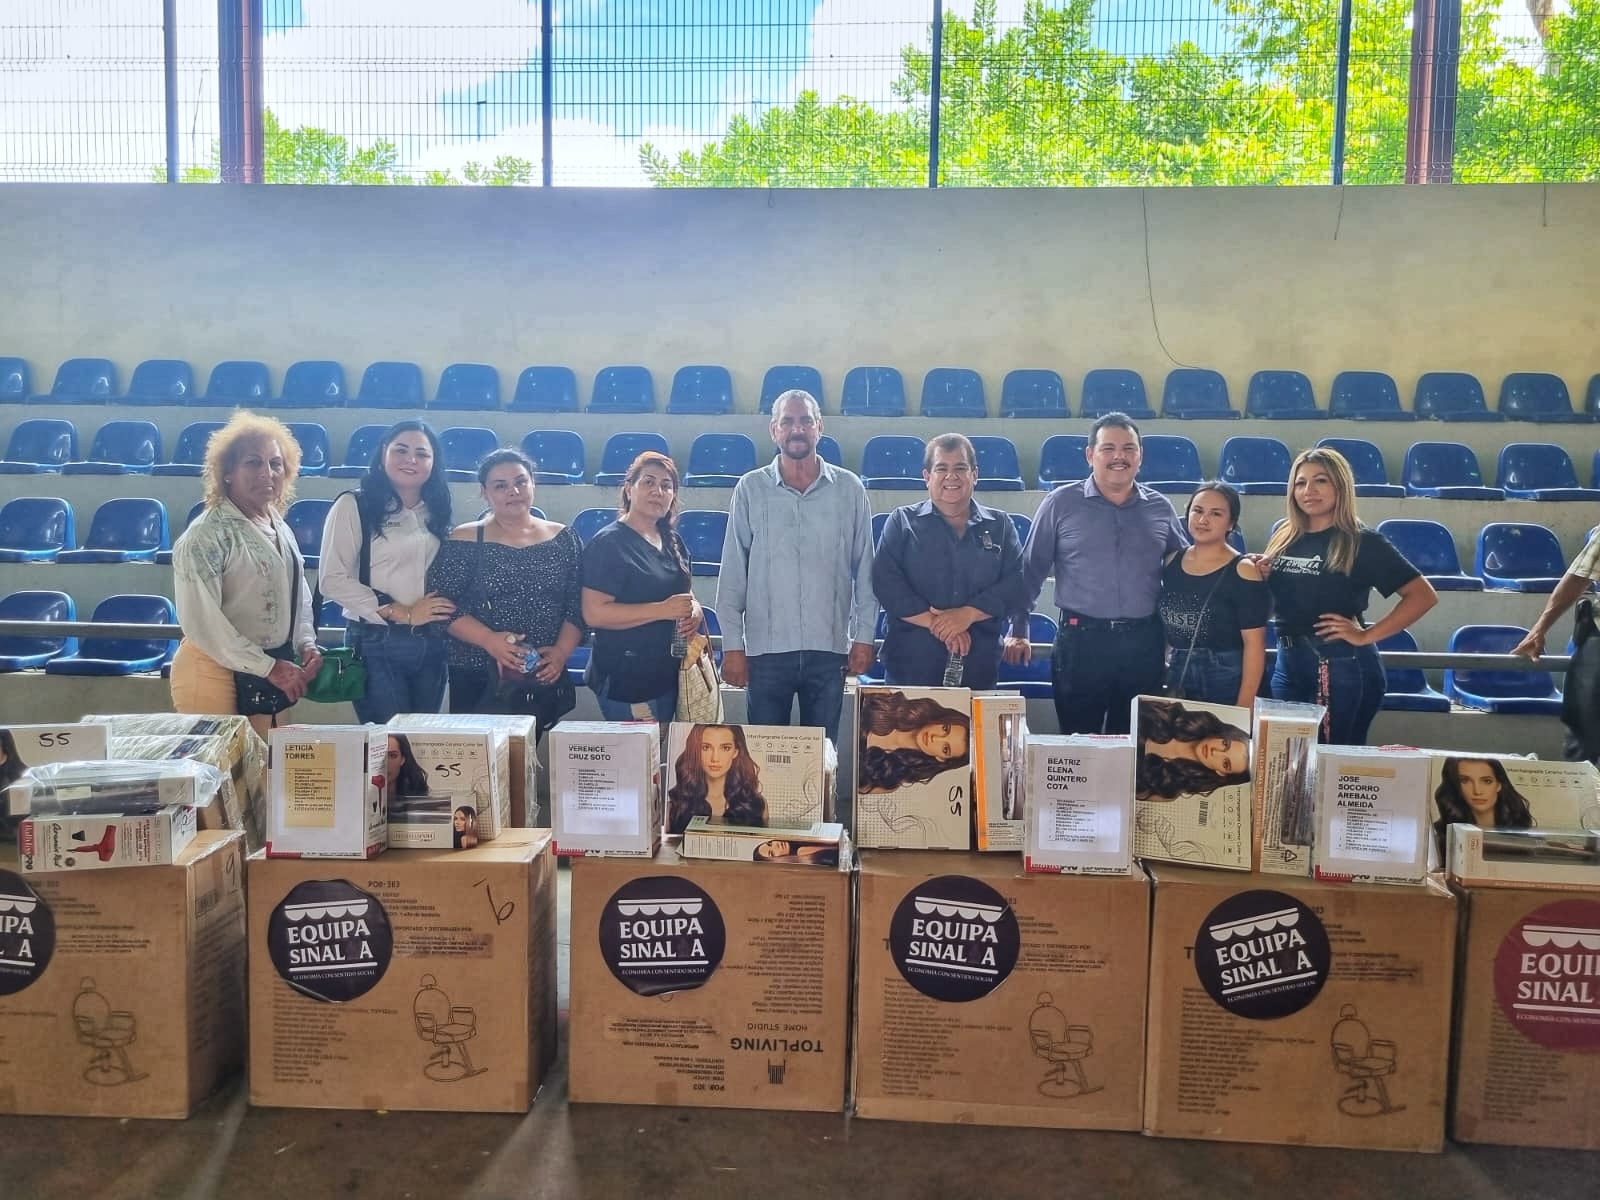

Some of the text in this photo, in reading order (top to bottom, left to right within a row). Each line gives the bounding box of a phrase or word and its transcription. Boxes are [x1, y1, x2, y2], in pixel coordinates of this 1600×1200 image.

[568, 745, 606, 753] VERENICE
[285, 752, 315, 760] TORRES
[568, 753, 589, 761] CRUZ
[1047, 757, 1081, 766] BEATRIZ
[1047, 766, 1074, 774] ELENA
[1046, 774, 1088, 783] QUINTERO
[1338, 775, 1360, 783] JOSE
[1046, 783, 1069, 791] COTA
[1337, 784, 1380, 792] SOCORRO
[1337, 792, 1378, 801] AREBALO
[1337, 800, 1374, 809] ALMEIDA
[287, 918, 371, 945] EQUIPA
[619, 917, 704, 940] EQUIPA
[911, 918, 999, 944] EQUIPA
[1215, 928, 1307, 966] EQUIPA
[1520, 953, 1600, 978] EQUI
[747, 1023, 808, 1031] HOME STUDIO
[730, 1037, 824, 1053] TOPLIVING
